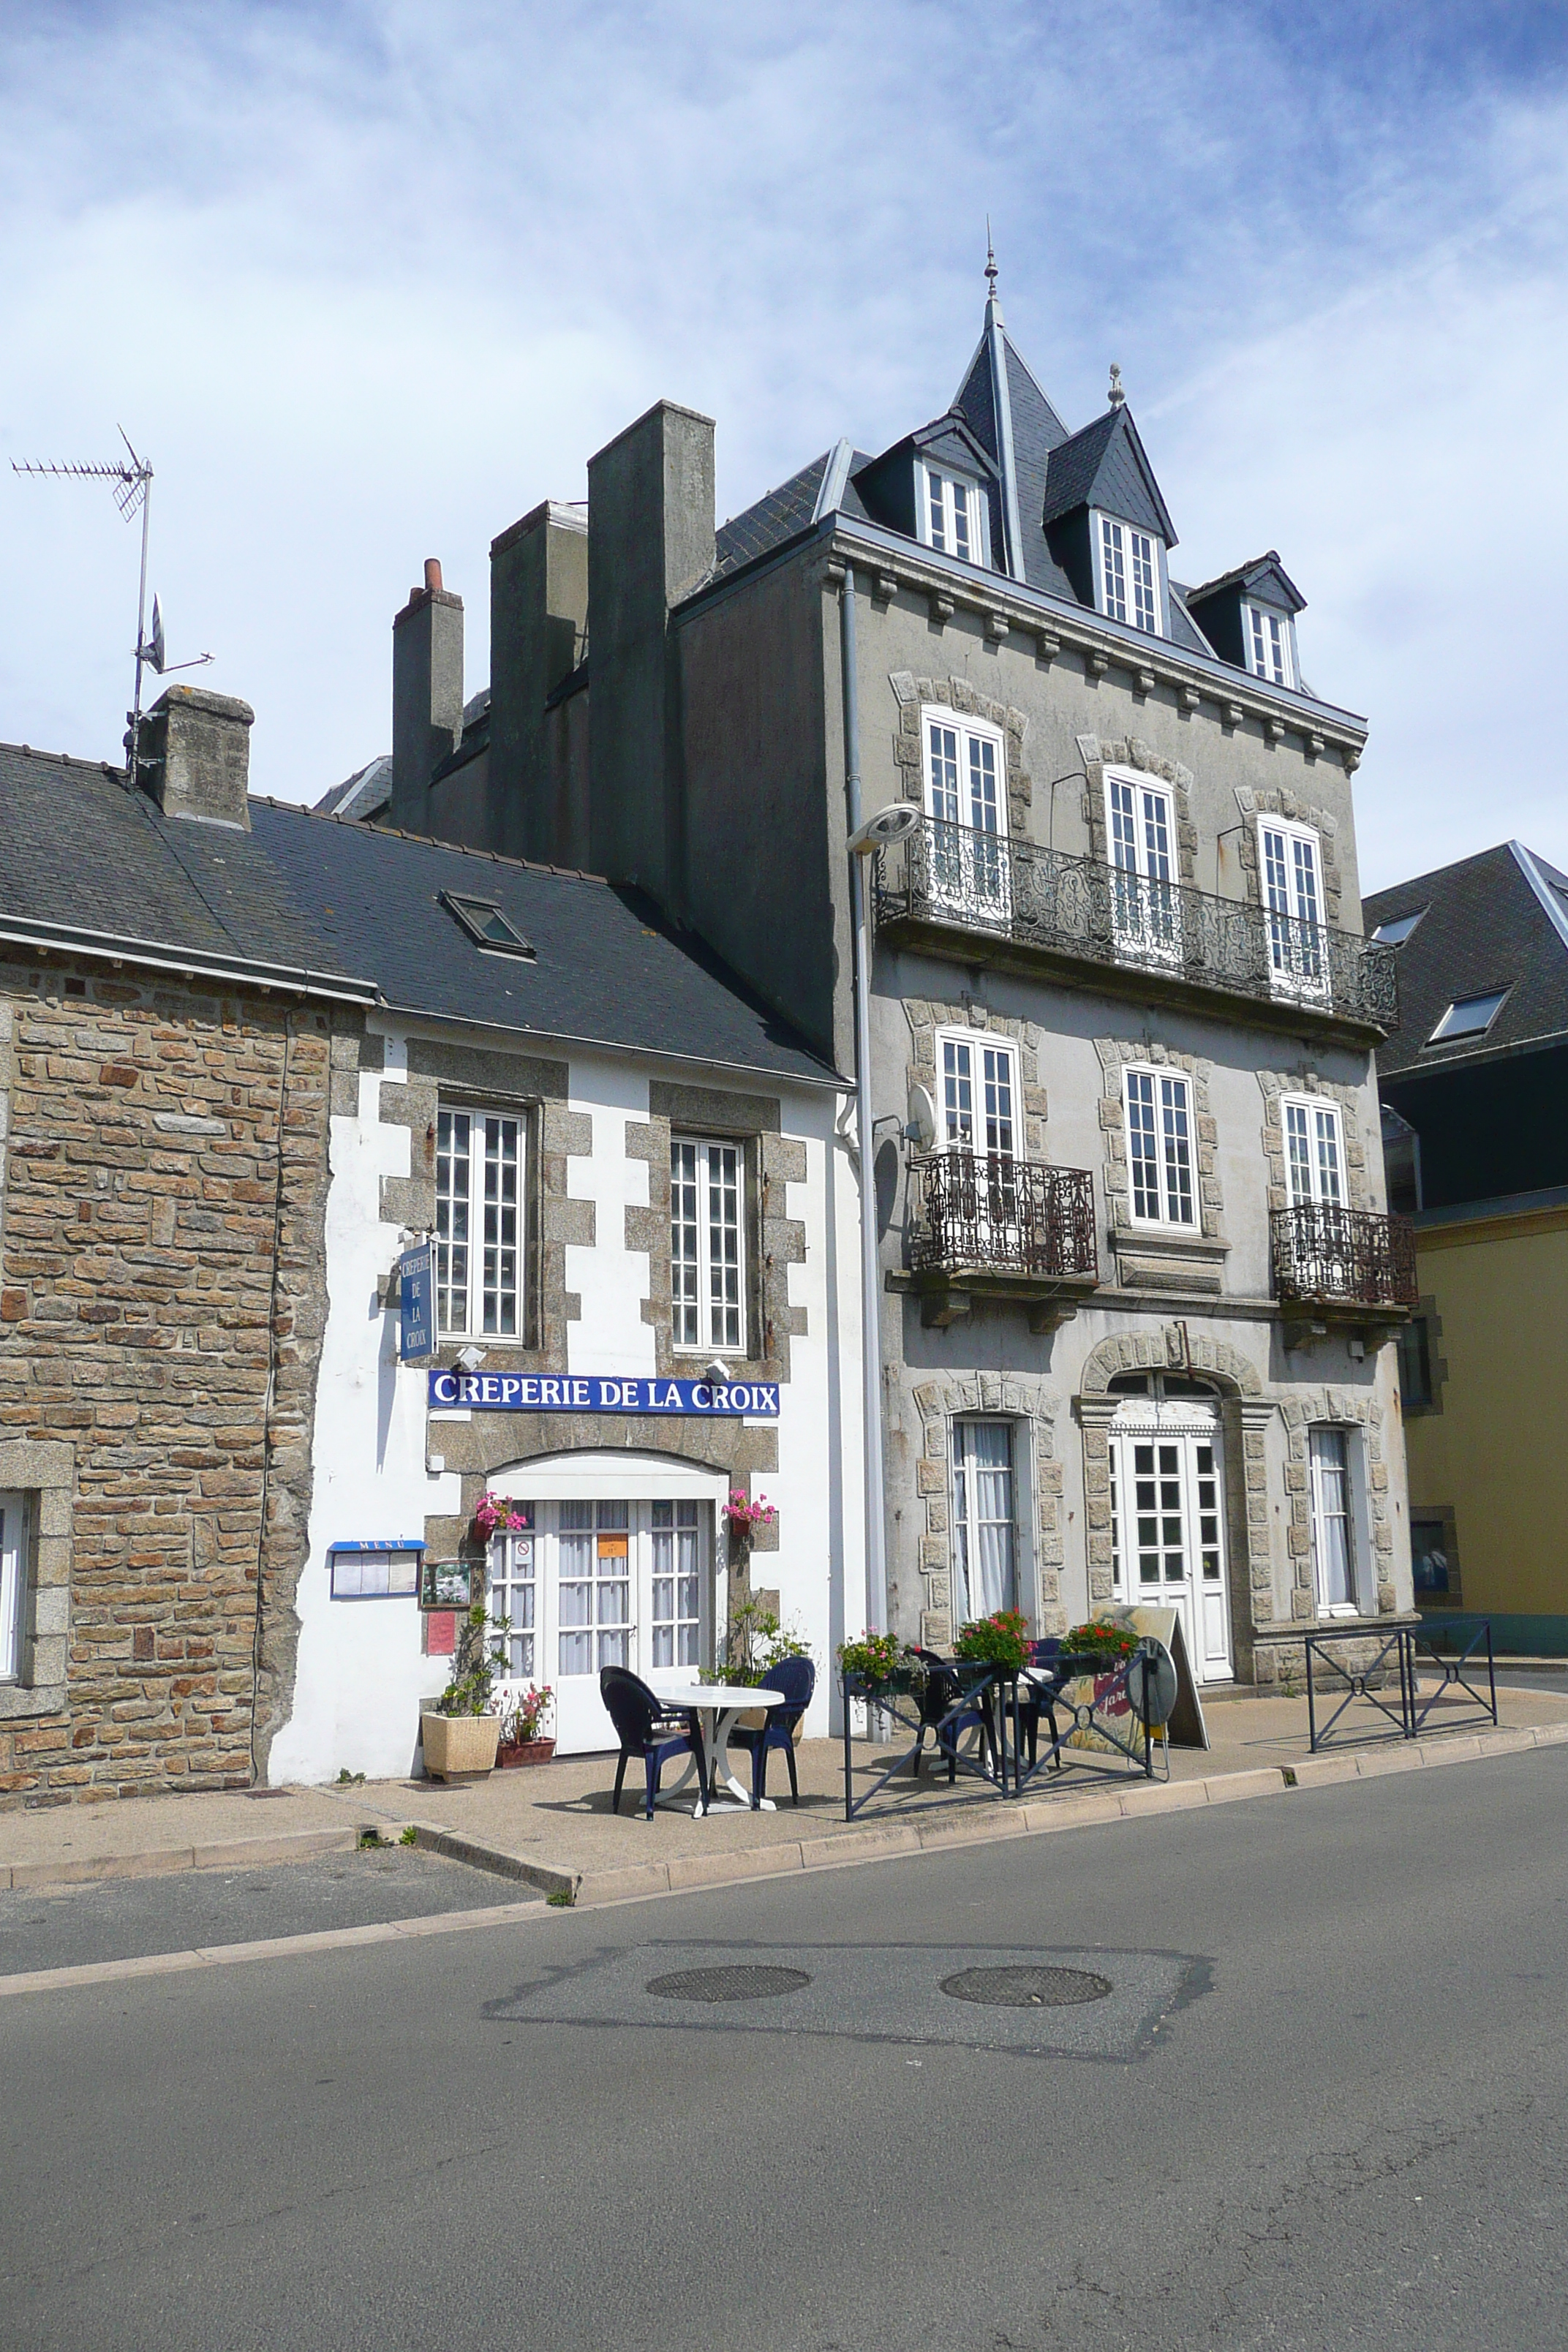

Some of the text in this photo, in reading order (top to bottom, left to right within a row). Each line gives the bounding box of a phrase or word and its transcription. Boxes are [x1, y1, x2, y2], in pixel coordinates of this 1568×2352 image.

[402, 1254, 429, 1278] CREPERIE
[412, 1282, 421, 1298] DE
[412, 1306, 421, 1323] LA
[407, 1329, 426, 1349] CROIX
[434, 1375, 777, 1411] CREPERIE DE LA CROIX
[359, 1540, 404, 1550] MENU
